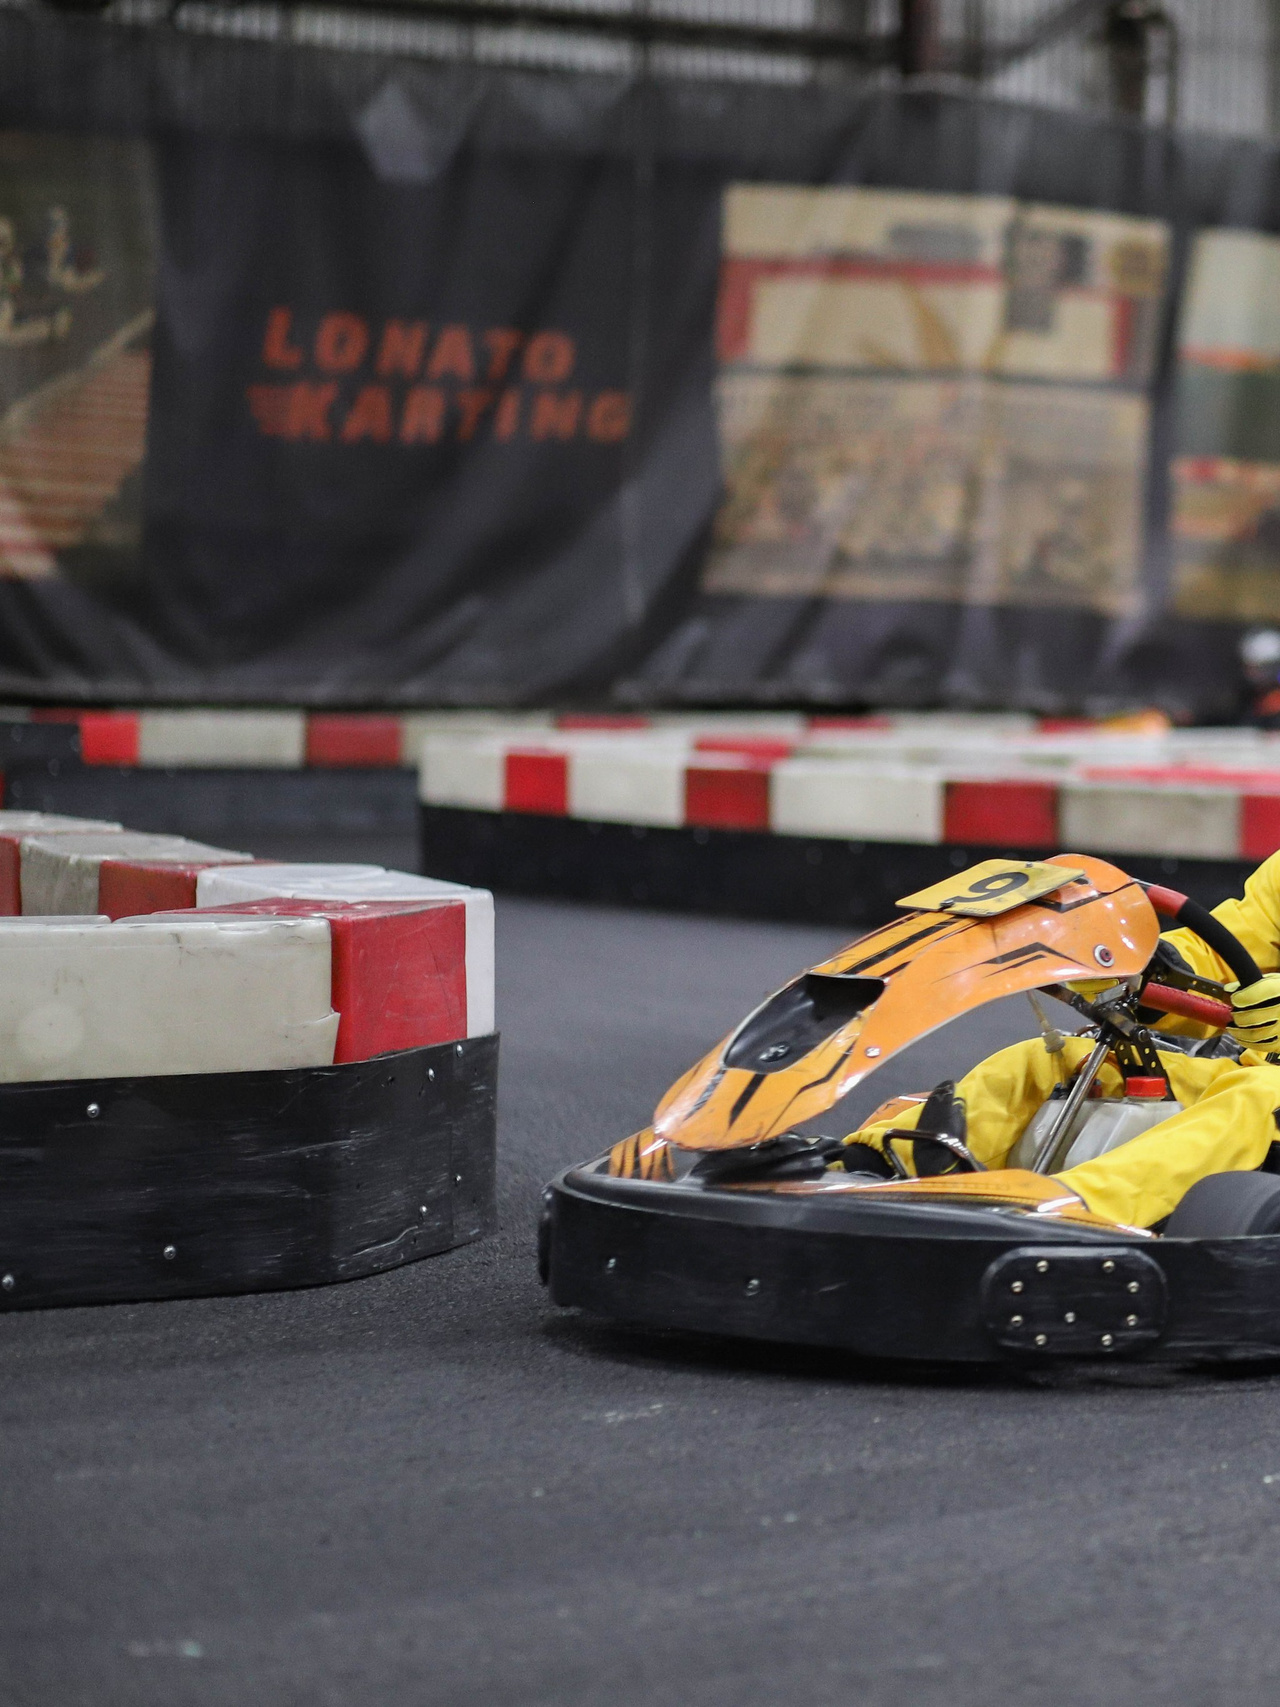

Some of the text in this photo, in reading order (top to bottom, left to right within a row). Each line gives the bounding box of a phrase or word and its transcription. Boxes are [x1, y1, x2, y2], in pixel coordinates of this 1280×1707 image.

[263, 306, 577, 384] LONATO
[286, 382, 632, 444] KARTING
[946, 871, 1029, 904] 9
